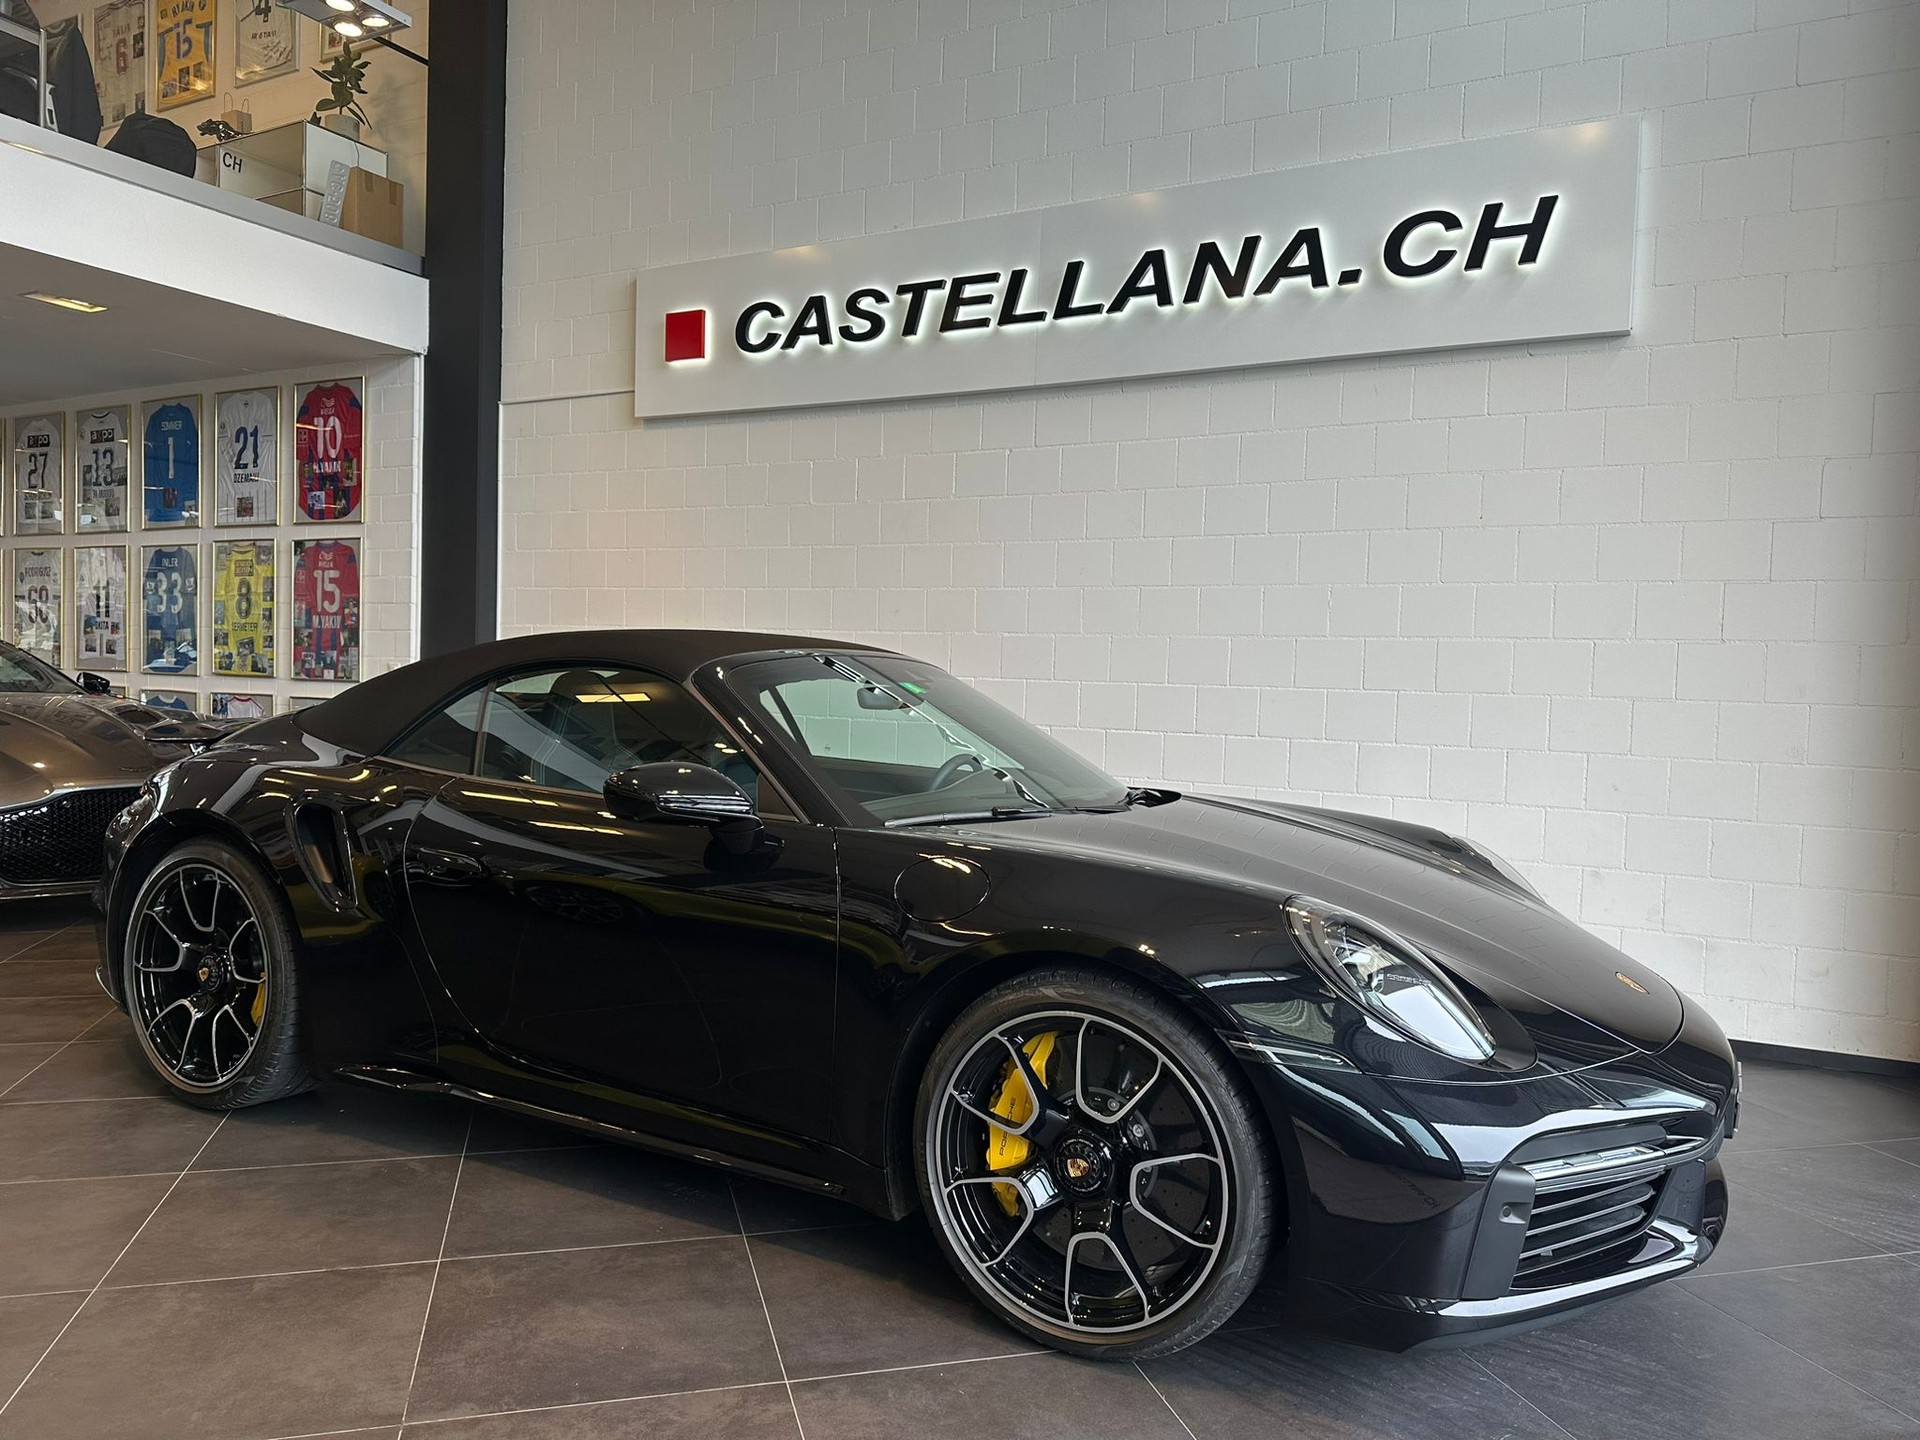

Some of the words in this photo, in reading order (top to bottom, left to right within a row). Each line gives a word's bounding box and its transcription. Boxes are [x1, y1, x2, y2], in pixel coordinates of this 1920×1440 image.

[173, 19, 193, 59] 15
[222, 152, 243, 173] CH
[736, 195, 1558, 352] CASTELLANA.CH
[168, 437, 175, 479] 1
[234, 425, 259, 470] 21
[314, 415, 342, 459] 10
[28, 451, 48, 489] 27
[92, 448, 114, 487] 13
[161, 557, 178, 567] INLER
[157, 572, 182, 614] 33
[235, 577, 252, 620] 8
[313, 569, 340, 613] 15
[999, 1097, 1017, 1156] PORCHE
